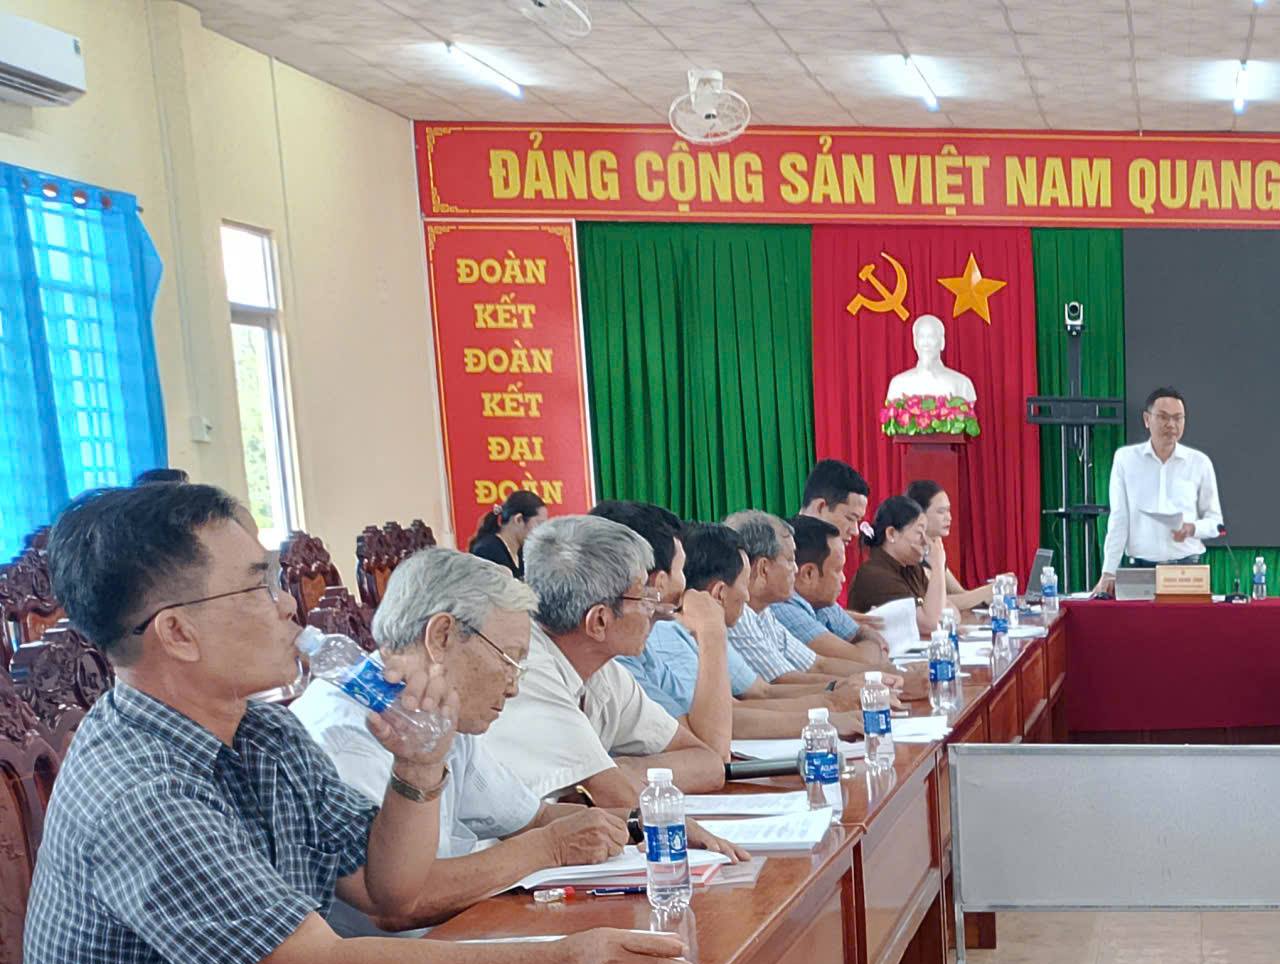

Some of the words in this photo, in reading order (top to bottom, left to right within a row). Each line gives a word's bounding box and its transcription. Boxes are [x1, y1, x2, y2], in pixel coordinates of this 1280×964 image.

[489, 130, 620, 201] ĐẢNG
[635, 141, 764, 212] CỘNG
[779, 134, 876, 204] SẢN
[890, 144, 990, 216] VIỆT
[1005, 155, 1112, 208] NAM
[456, 250, 547, 285] ĐOÀN
[474, 294, 537, 330] KẾT
[463, 338, 554, 374] ĐOÀN
[481, 382, 543, 418] KẾT
[487, 435, 545, 468] ĐẠI
